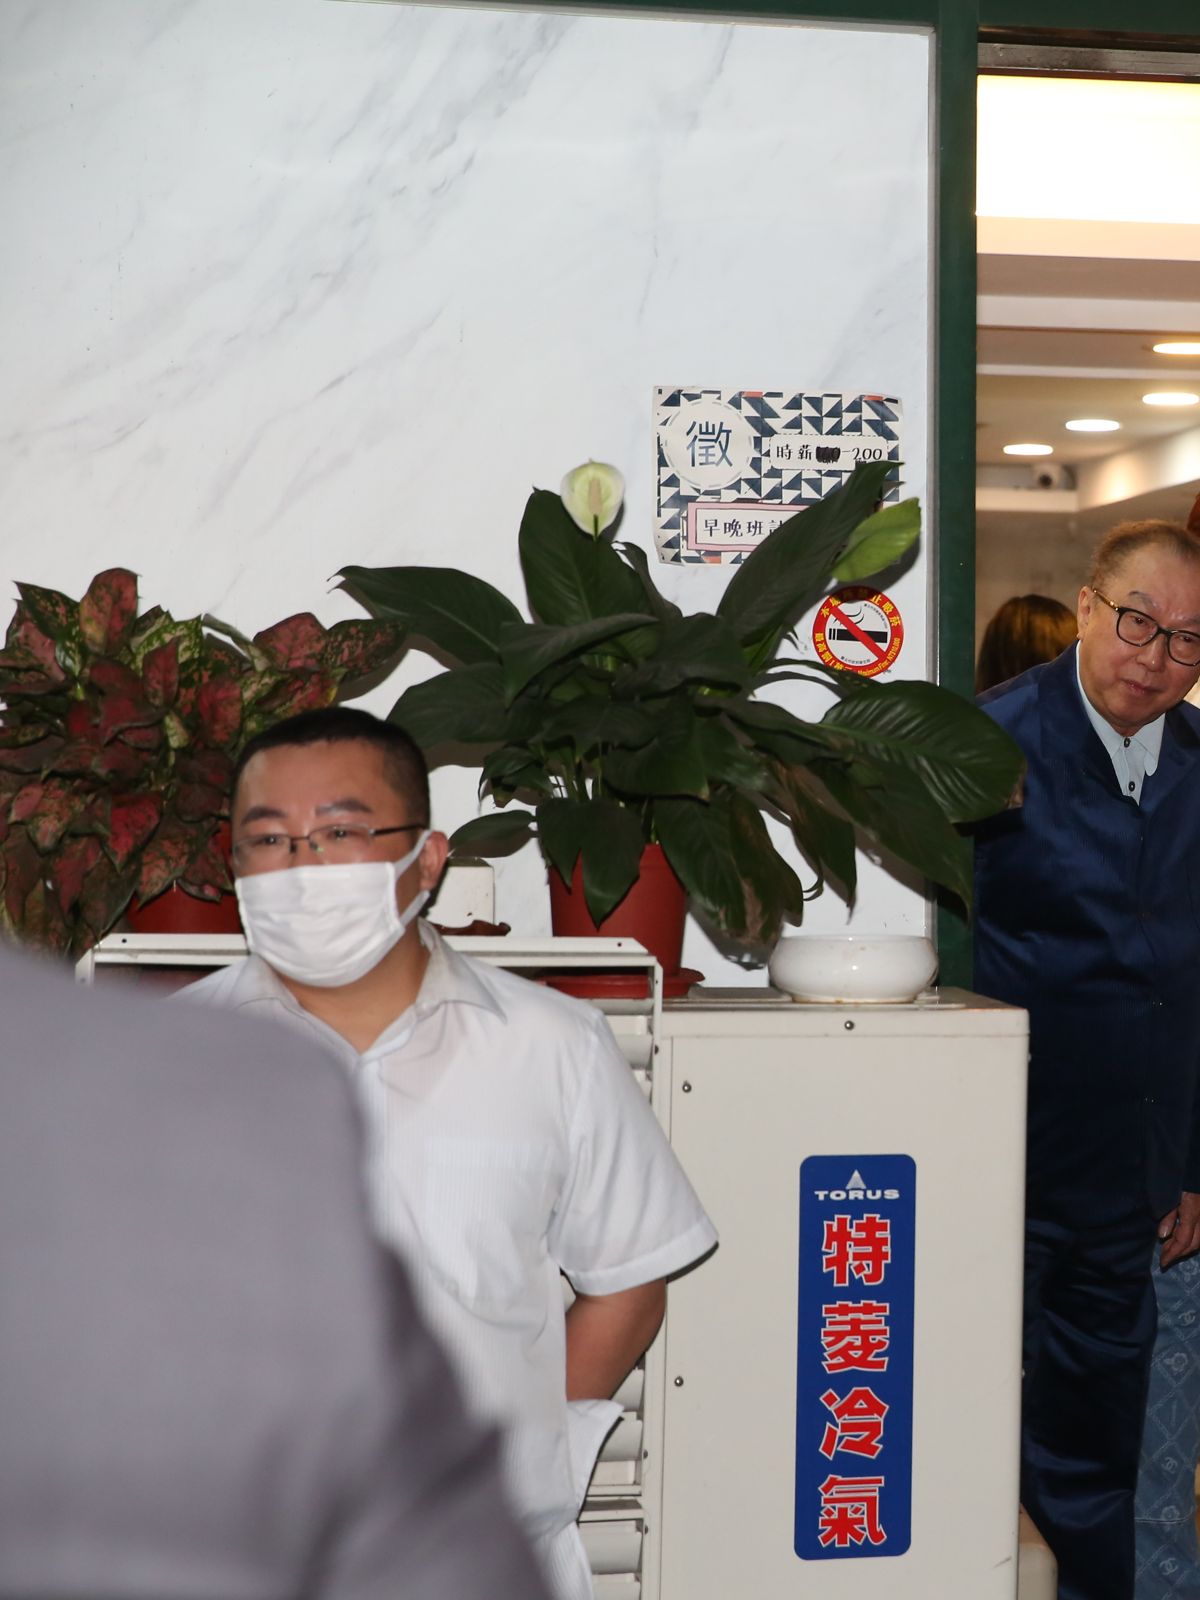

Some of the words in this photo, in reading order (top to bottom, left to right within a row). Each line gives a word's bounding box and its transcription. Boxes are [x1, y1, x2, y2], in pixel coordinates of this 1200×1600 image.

[686, 420, 734, 468] 徵
[814, 1188, 900, 1201] TORUS
[818, 1213, 891, 1548] 特菱冷氣
